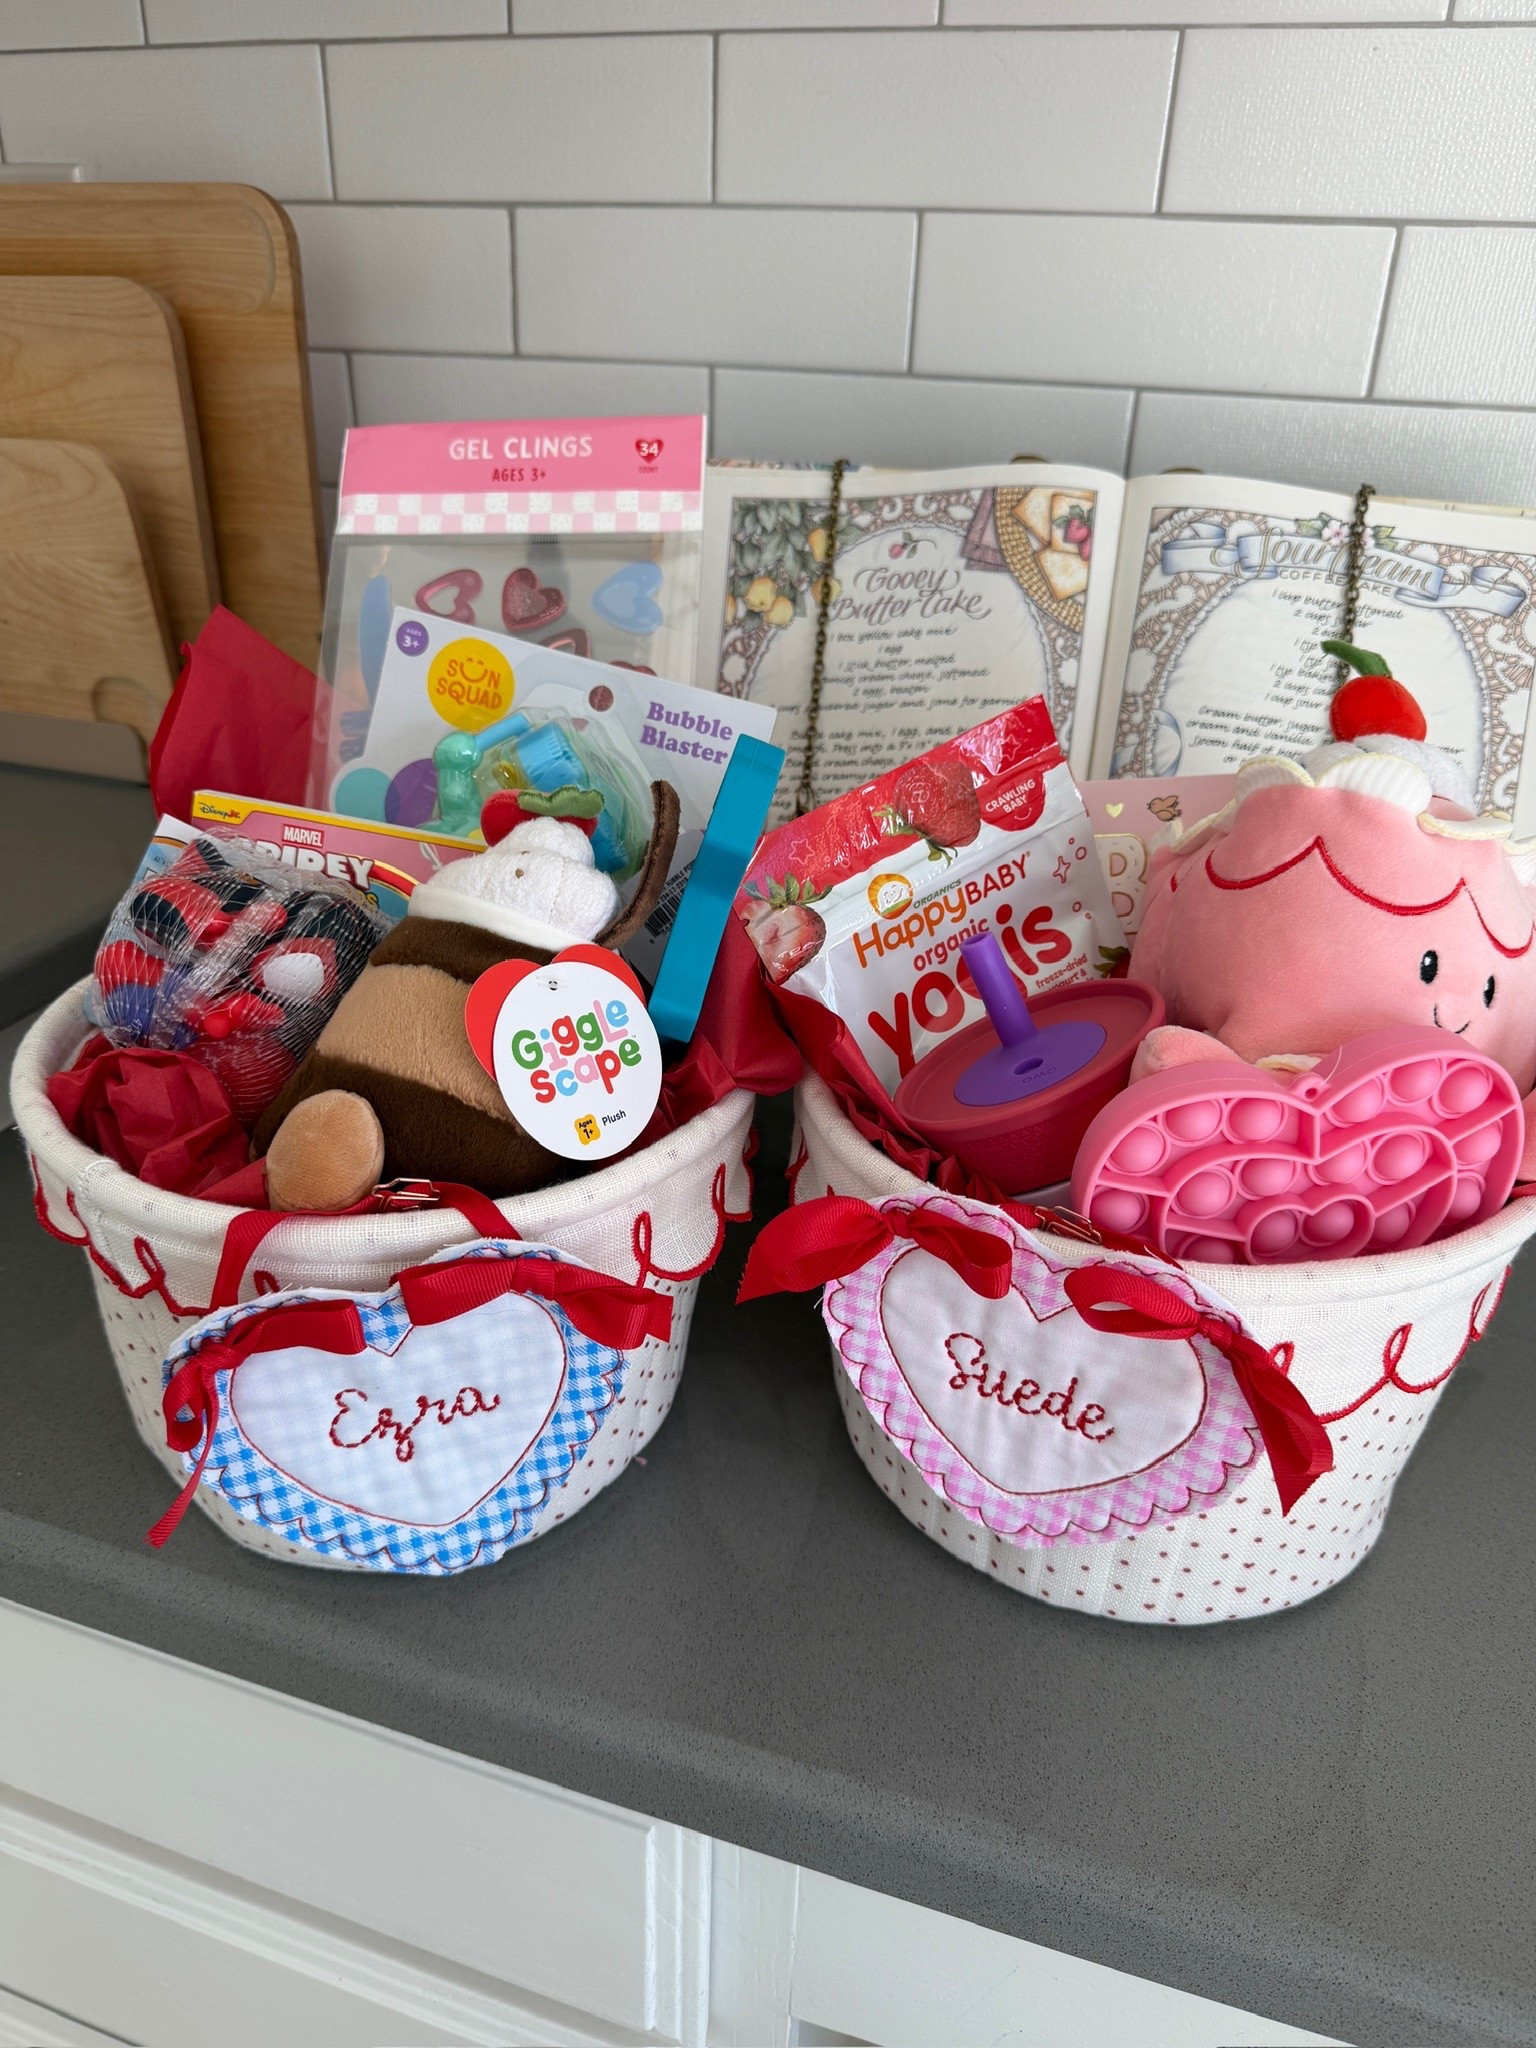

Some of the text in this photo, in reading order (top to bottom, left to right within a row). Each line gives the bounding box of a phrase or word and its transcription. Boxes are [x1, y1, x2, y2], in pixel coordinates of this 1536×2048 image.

[449, 436, 593, 460] GEL CLINGS
[638, 442, 659, 457] 34
[492, 468, 546, 482] AGES 3+
[1232, 527, 1330, 579] Sour
[853, 567, 960, 597] Gooey
[1279, 568, 1393, 594] COFFEE AKE
[829, 590, 992, 626] Butter Cake
[402, 635, 419, 648] 3+
[406, 628, 421, 637] AGES
[447, 659, 501, 689] SUN
[436, 677, 502, 709] SQUAD
[646, 701, 733, 740] Bubble
[639, 724, 728, 764] Blaster
[198, 801, 230, 819] Disney
[985, 779, 1036, 812] CRAWLING
[1003, 795, 1028, 813] BABY
[282, 826, 323, 847] MARVEL
[913, 878, 962, 910] ORGANICS
[913, 918, 991, 972] organic
[1036, 952, 1088, 988] freeze-dried
[578, 1119, 593, 1129] Ages
[602, 1109, 627, 1126] Plush
[583, 1128, 594, 1139] 1+
[945, 1332, 1115, 1443] Suede
[329, 1386, 501, 1463] Ezra
